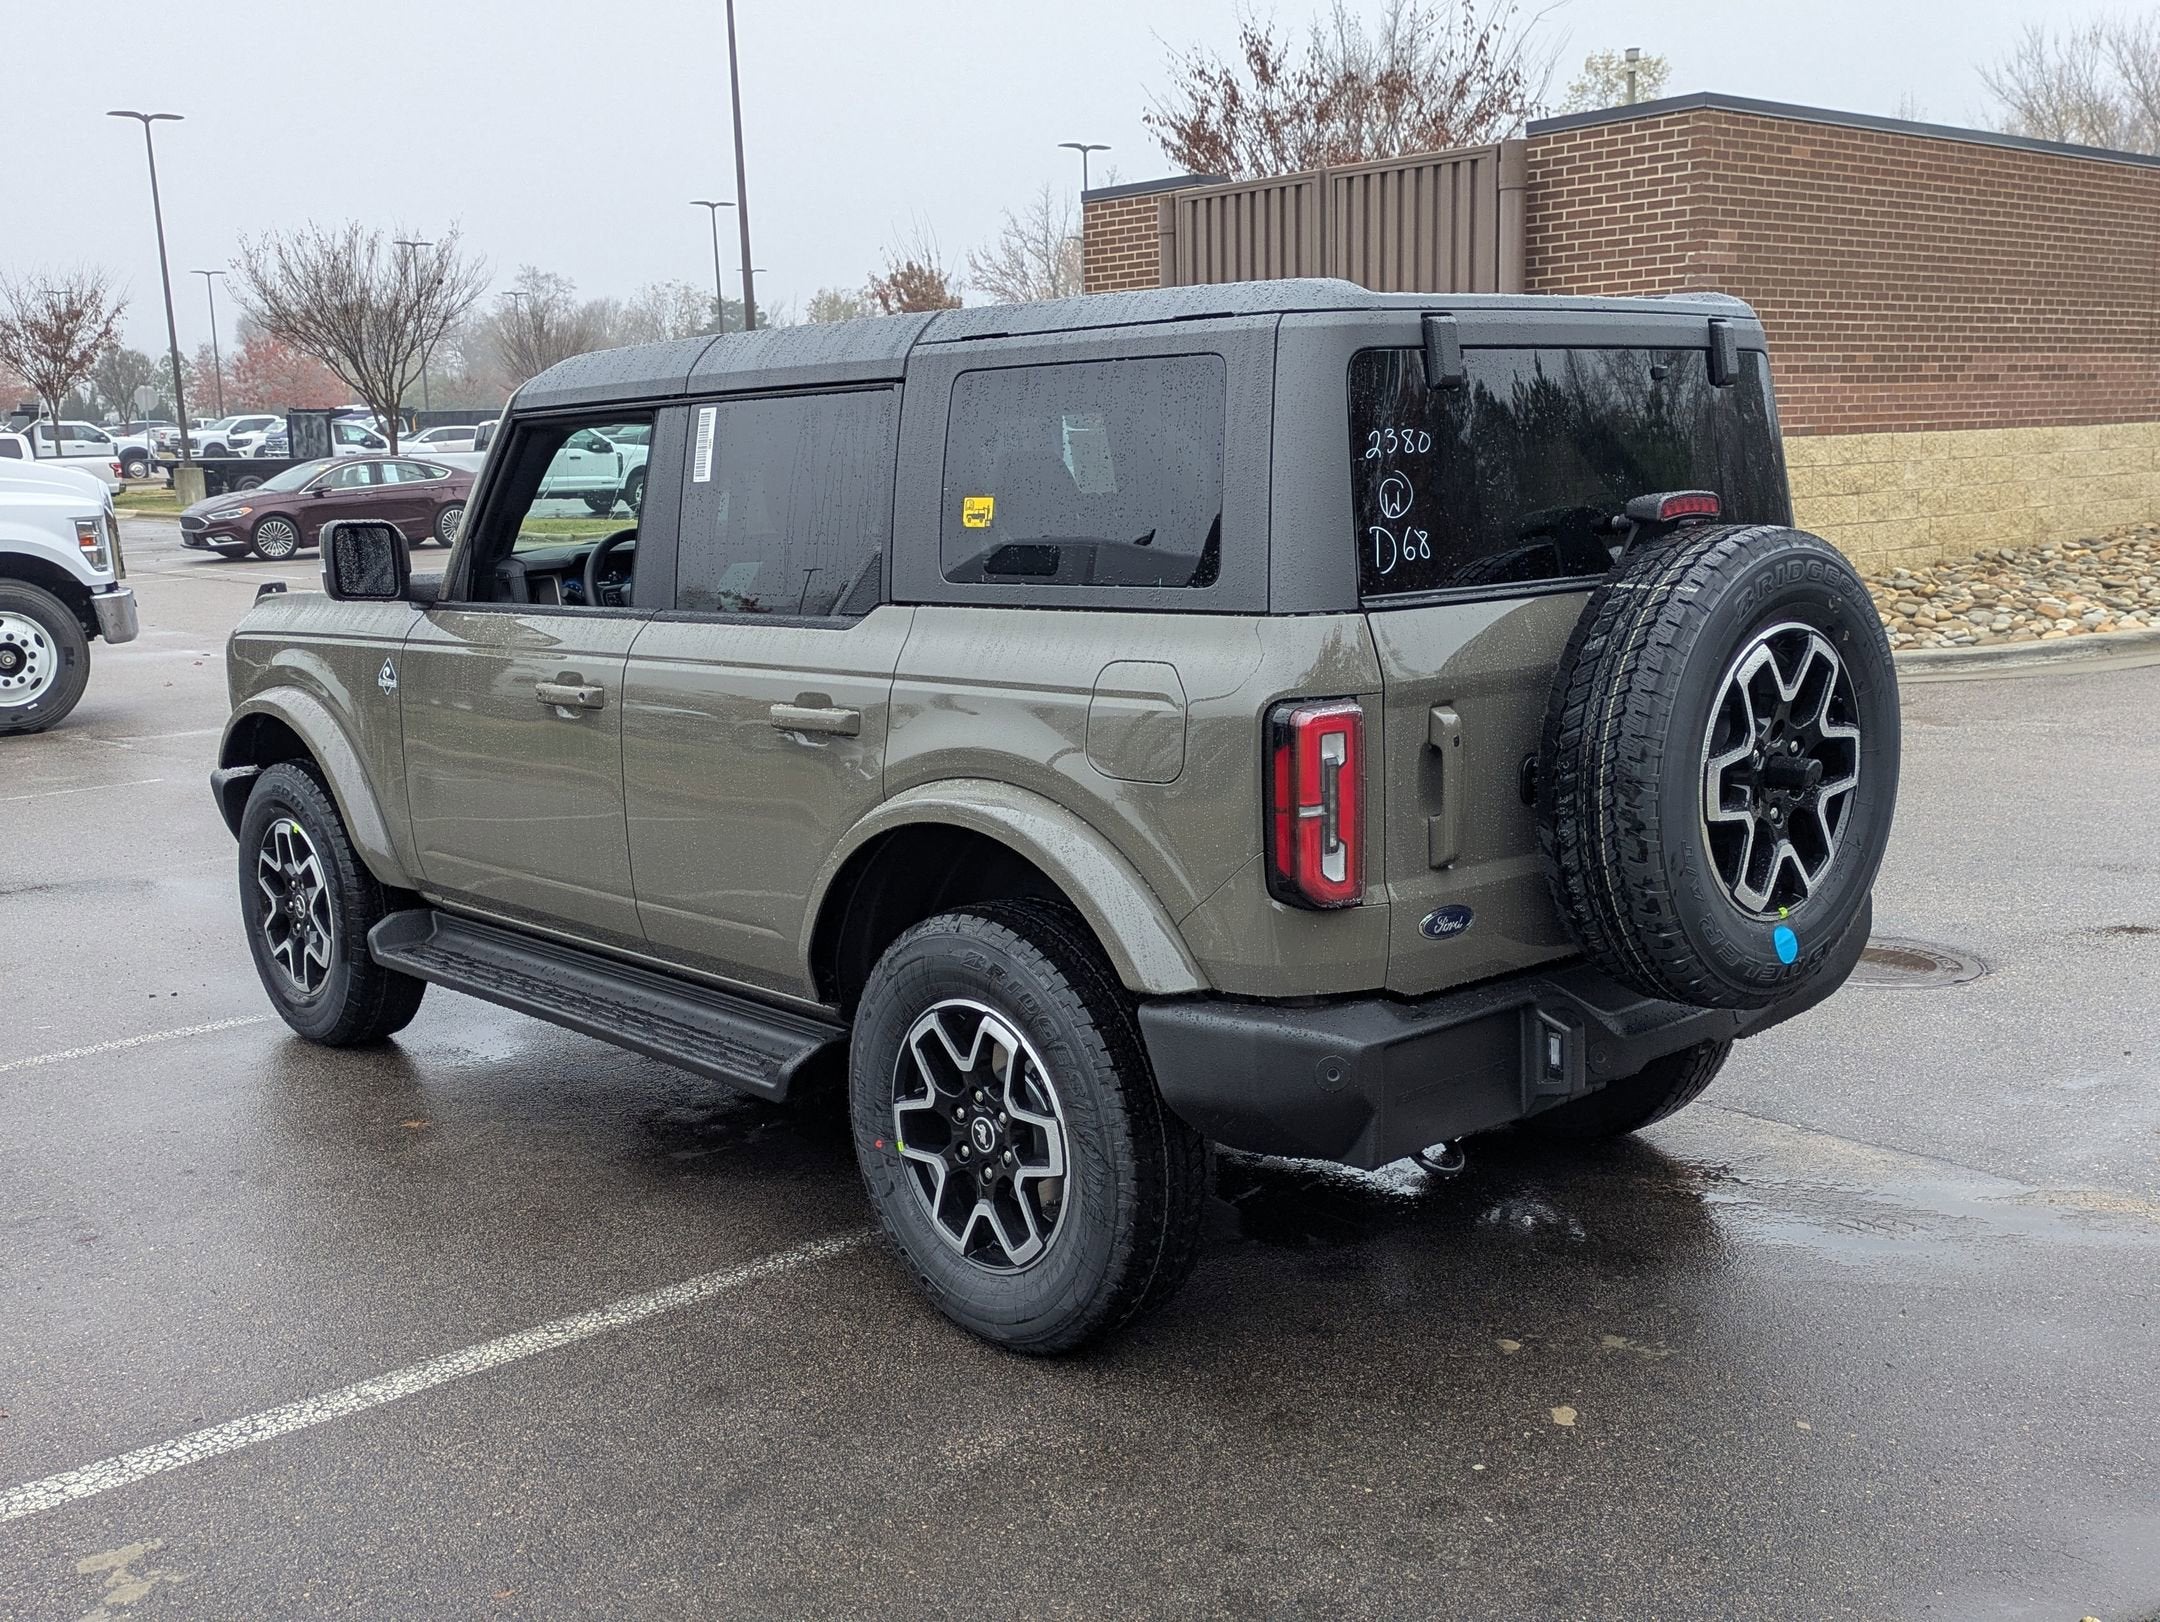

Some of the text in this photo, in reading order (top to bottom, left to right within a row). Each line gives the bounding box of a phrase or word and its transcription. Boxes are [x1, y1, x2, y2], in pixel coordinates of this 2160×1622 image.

[1365, 428, 1431, 458] 2380
[1369, 526, 1430, 574] D68
[1736, 559, 1894, 677] BRIDGESTONE
[1434, 916, 1463, 933] Ford
